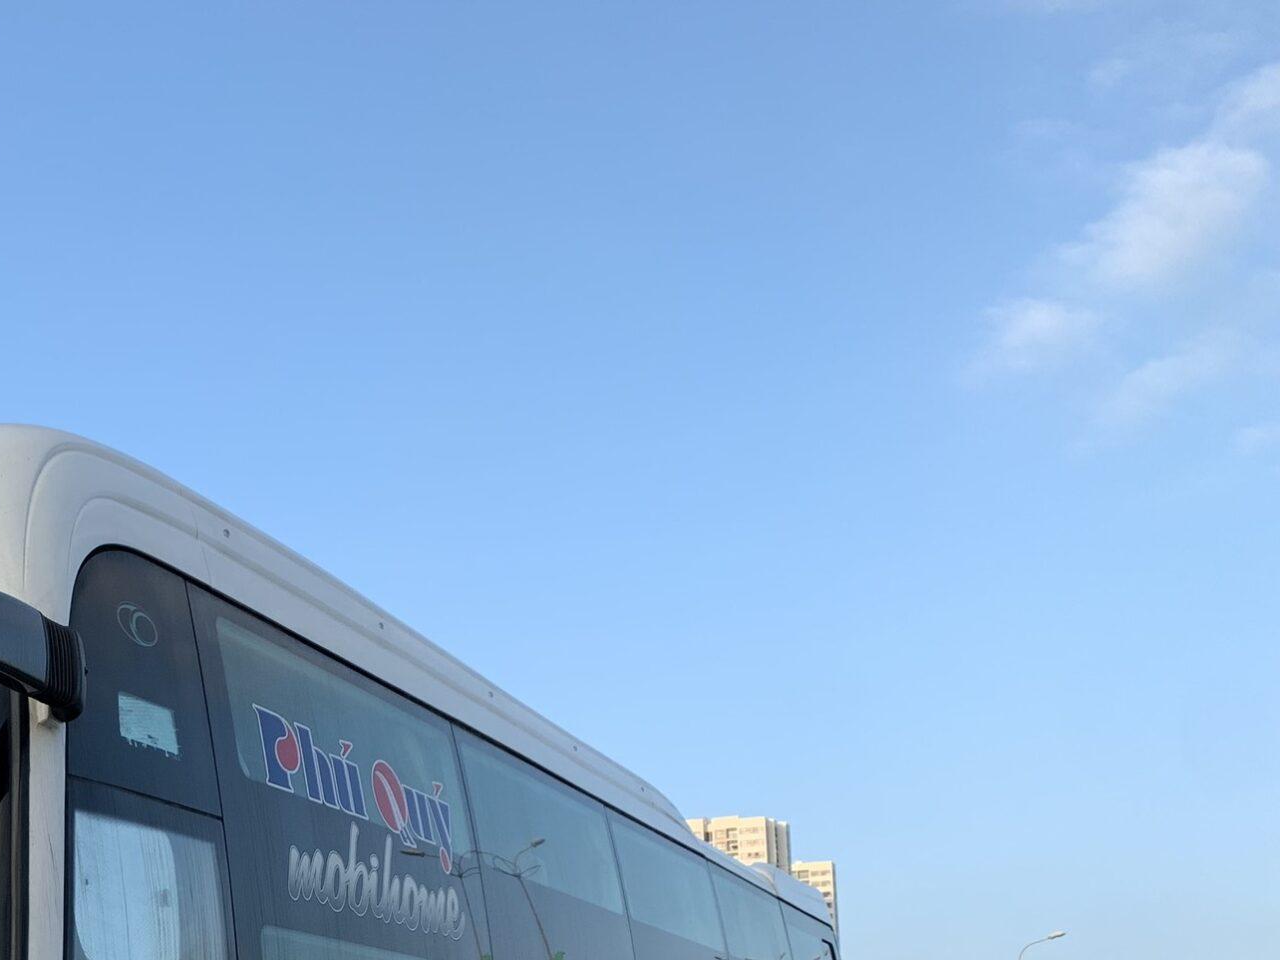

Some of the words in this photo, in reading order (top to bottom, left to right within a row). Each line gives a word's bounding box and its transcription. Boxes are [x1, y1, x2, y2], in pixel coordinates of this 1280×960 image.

[253, 702, 369, 820] Phú
[371, 759, 453, 875] Quý
[288, 821, 465, 941] mobihome
